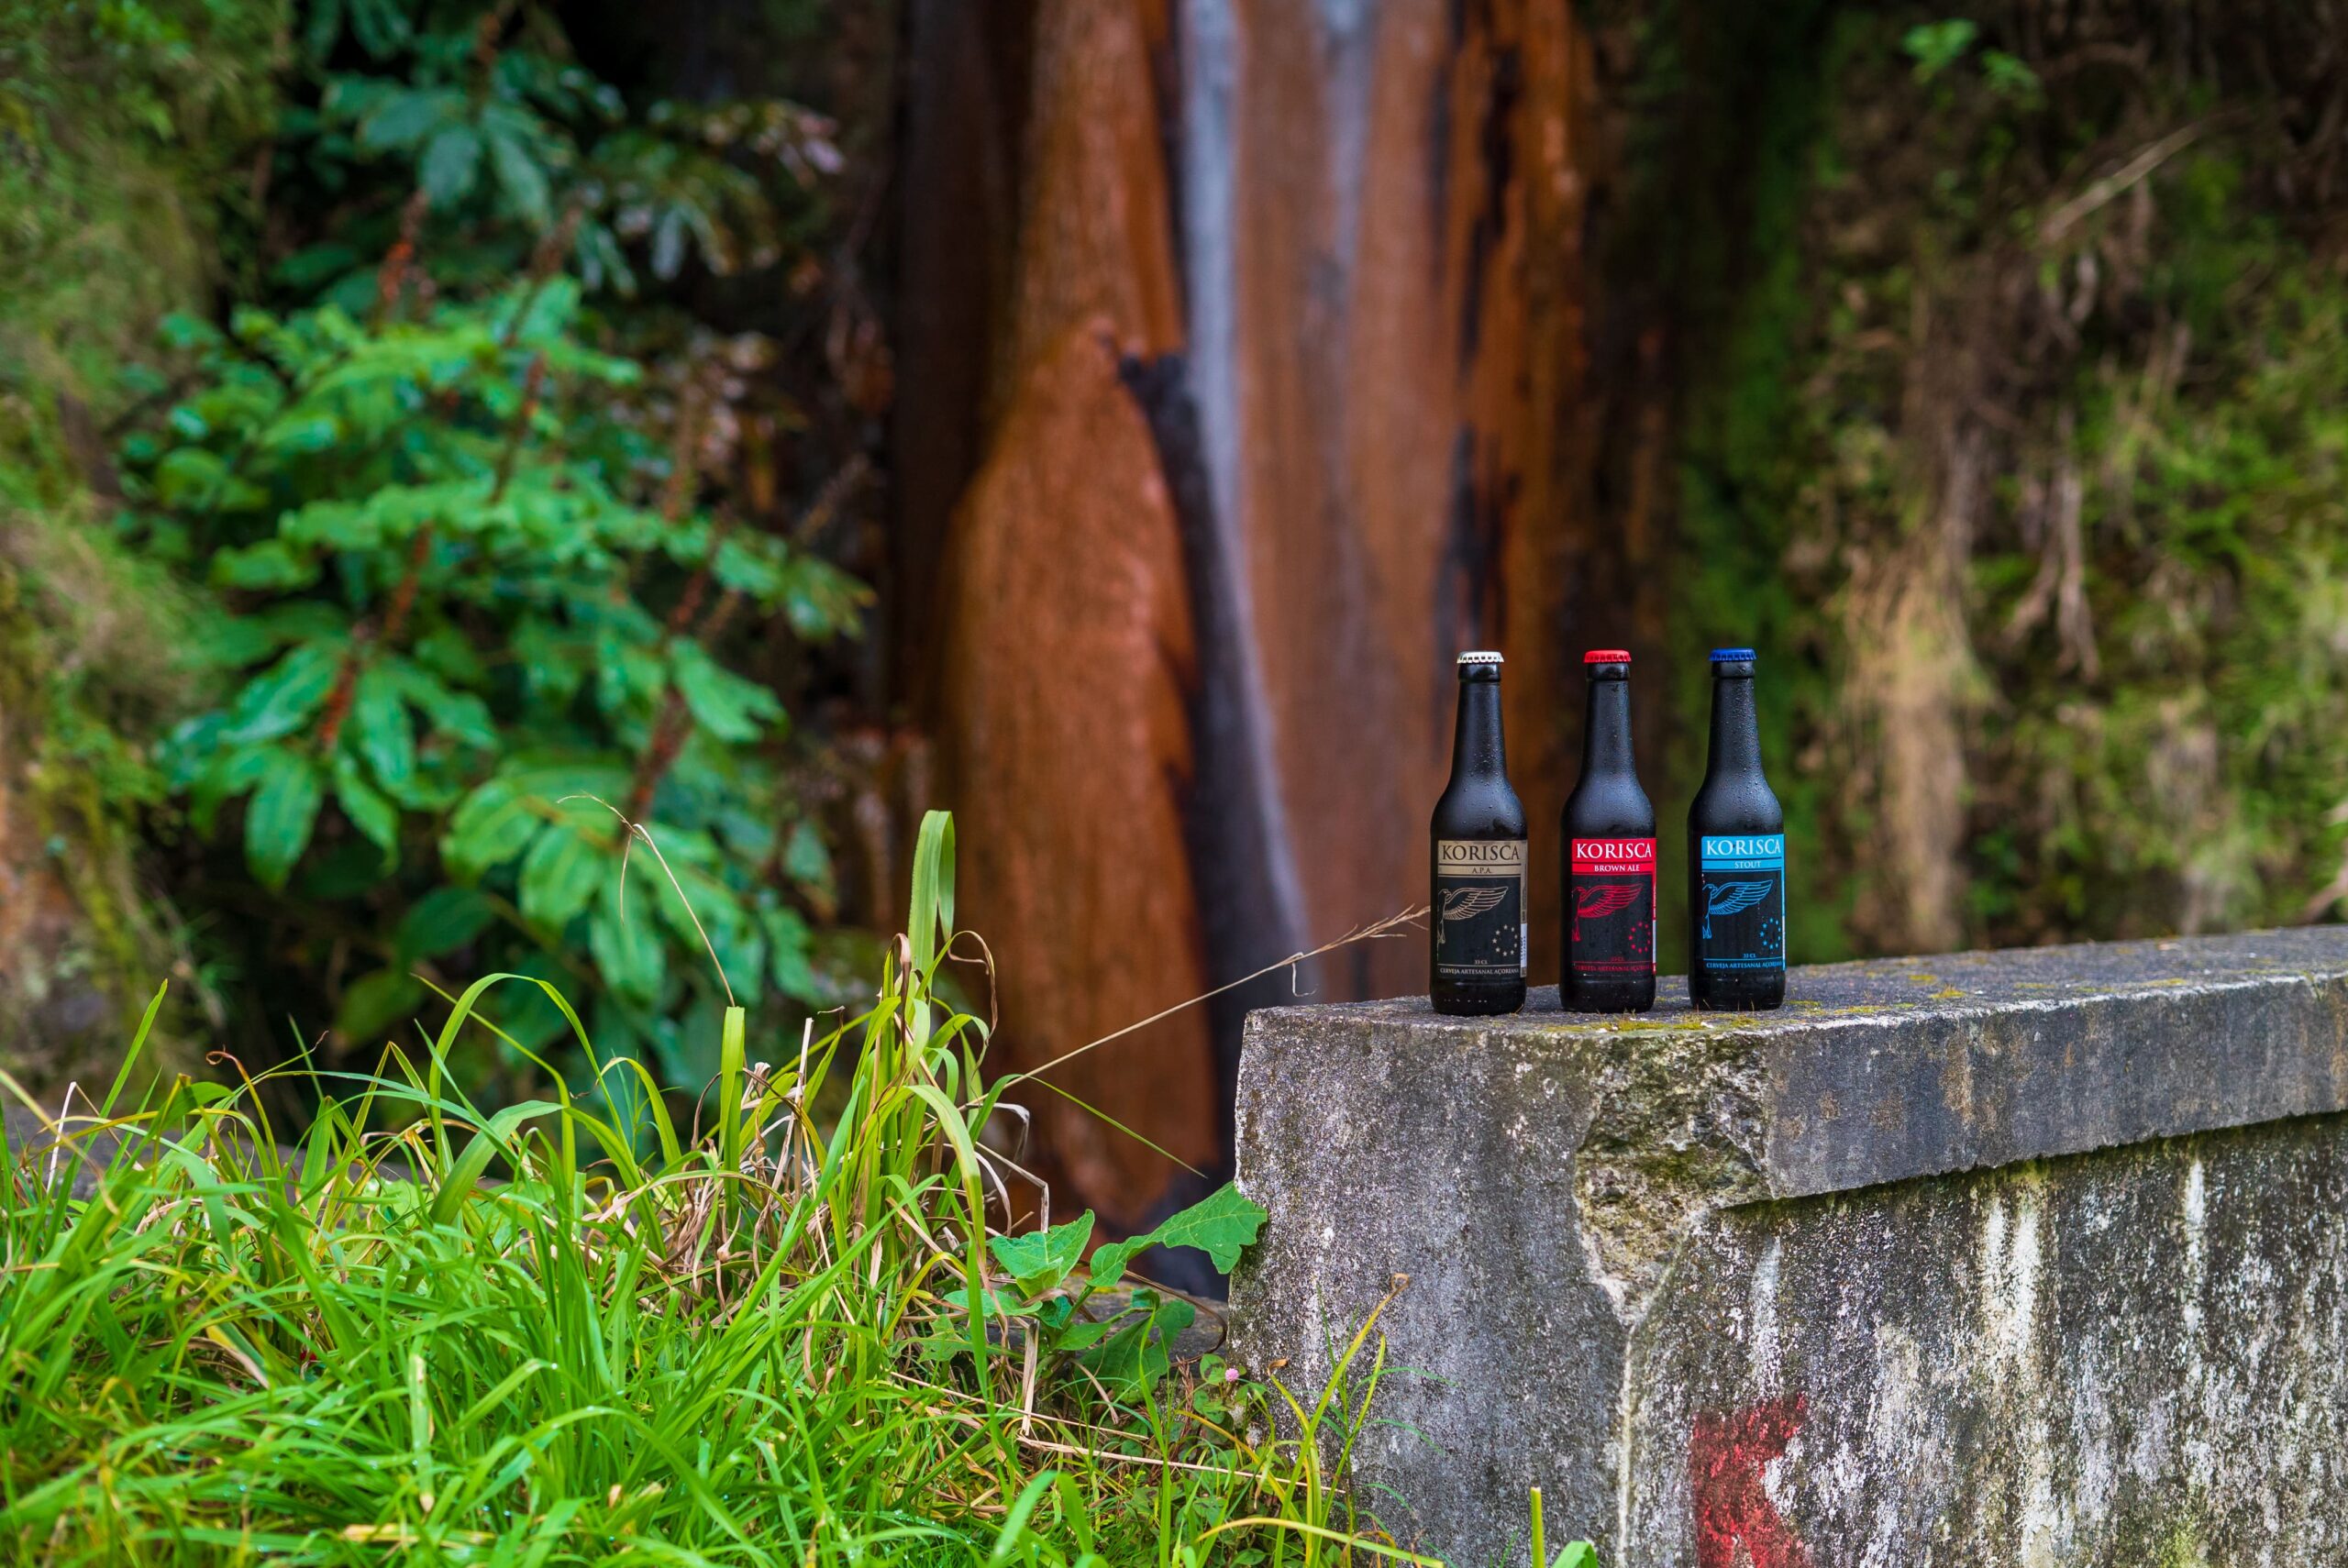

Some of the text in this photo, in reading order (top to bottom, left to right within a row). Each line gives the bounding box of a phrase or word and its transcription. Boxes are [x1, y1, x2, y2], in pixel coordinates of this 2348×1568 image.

[1442, 845, 1520, 860] KORISCA
[1577, 843, 1652, 858] KORISCA
[1707, 839, 1781, 856] KORISCA
